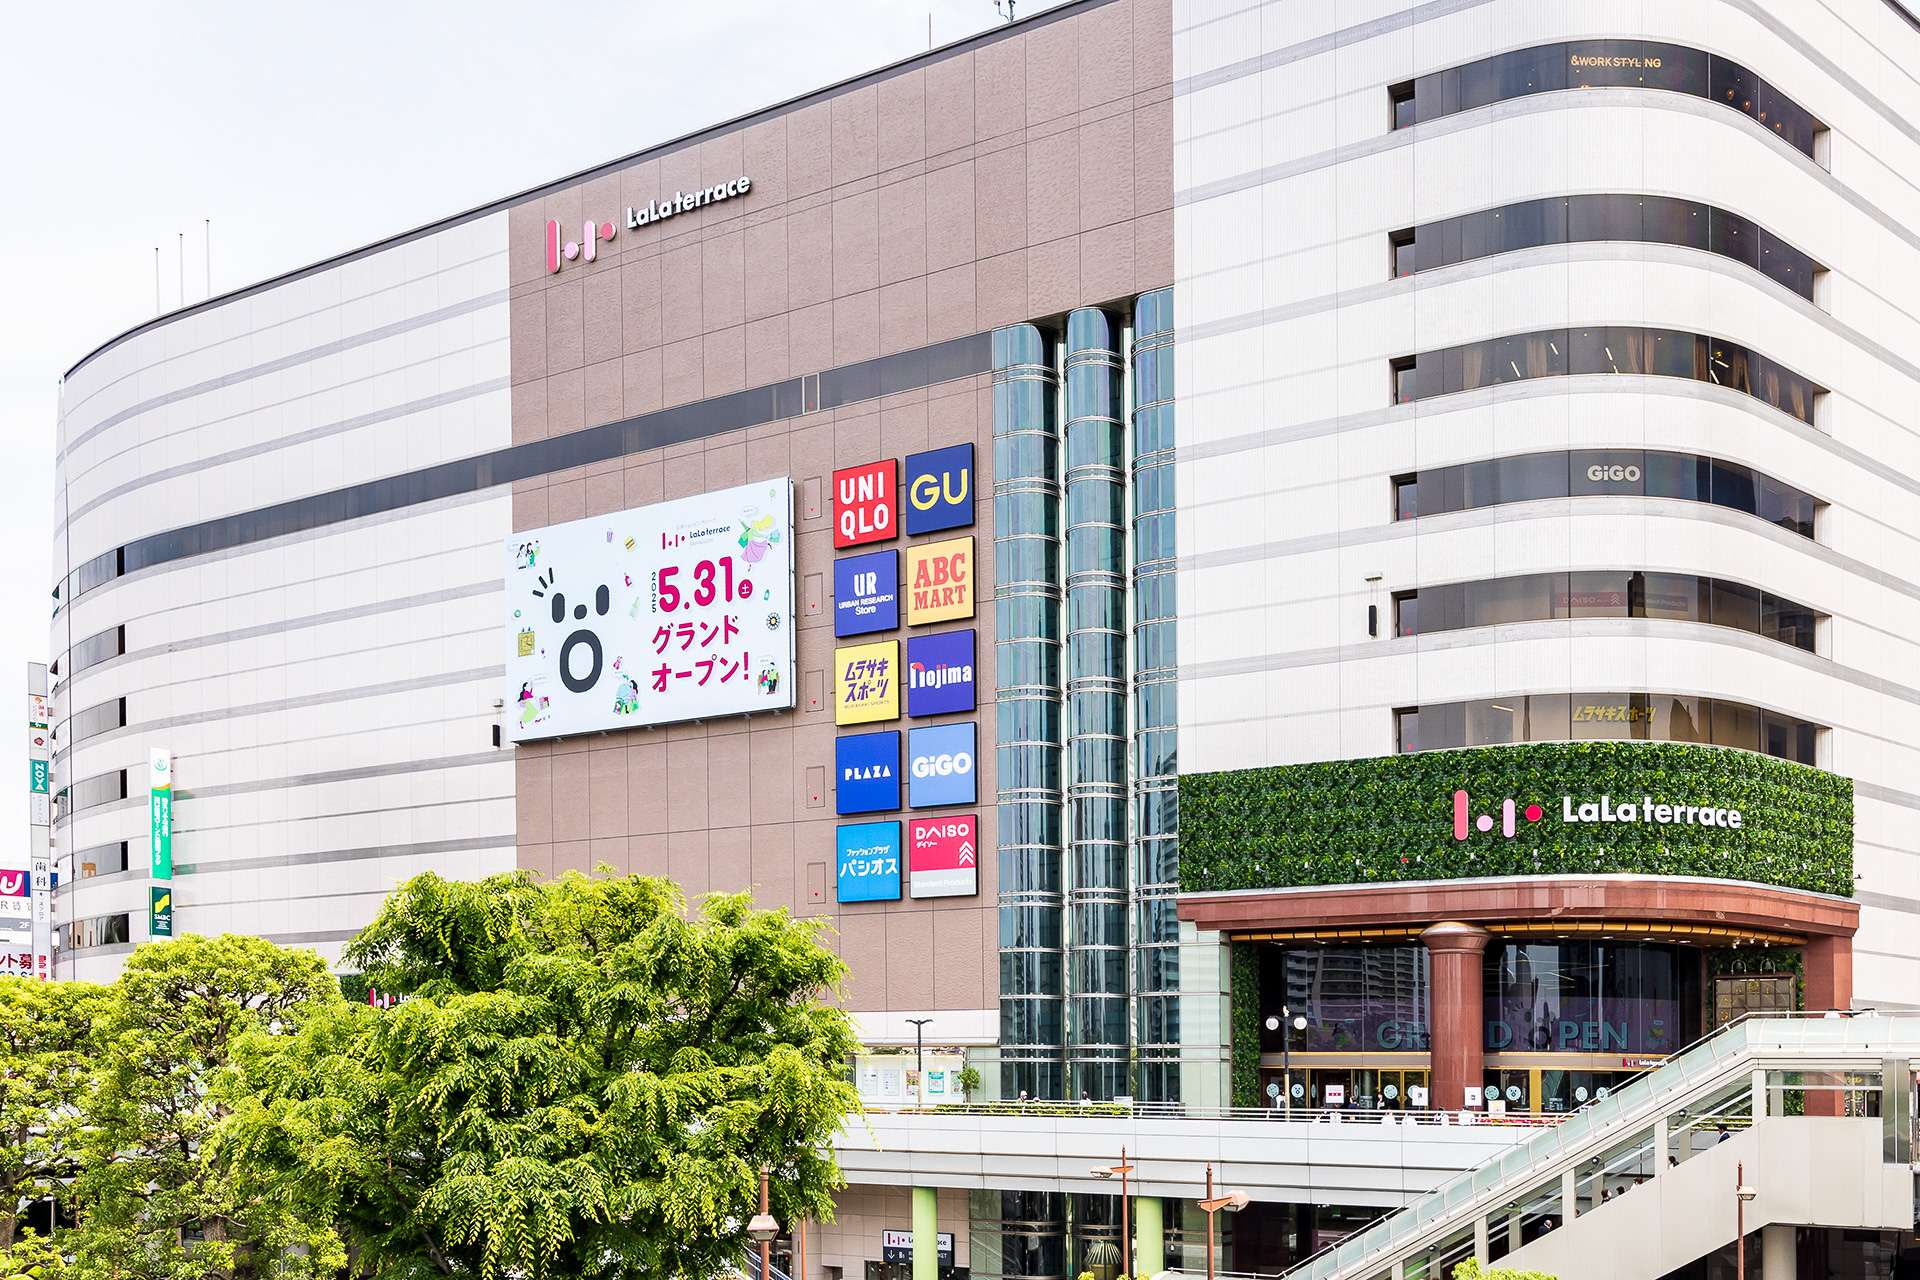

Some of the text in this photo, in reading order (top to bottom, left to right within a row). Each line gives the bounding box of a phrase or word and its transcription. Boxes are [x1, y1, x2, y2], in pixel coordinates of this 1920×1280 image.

[1613, 57, 1662, 68] STYLNG
[675, 176, 751, 213] terrace
[1587, 465, 1641, 482] GiGO
[840, 471, 884, 505] UNI
[910, 468, 968, 511] GU
[840, 503, 889, 540] QLO
[914, 552, 966, 589] ABC
[659, 556, 733, 612] 5.31
[854, 572, 877, 597] UR
[838, 594, 893, 609] URBAN RESEARCH
[855, 605, 876, 615] Store
[914, 585, 966, 611] MART
[652, 615, 739, 655] グランド
[652, 651, 749, 692] オープン!
[844, 658, 889, 681] ムラサキ
[844, 678, 889, 702] スポーツ
[34, 763, 45, 790] NOVA
[844, 765, 891, 781] PLAZA
[912, 752, 972, 779] GiGO
[1563, 795, 1742, 829] LaLa terrace
[915, 823, 969, 840] DAISO
[916, 840, 938, 848] ダイソー
[846, 845, 890, 857] ファッションプラザ
[839, 857, 898, 878] パシオス
[913, 878, 973, 889] Standard Products
[154, 913, 171, 921] SMBC
[1376, 1020, 1512, 1050] GRD
